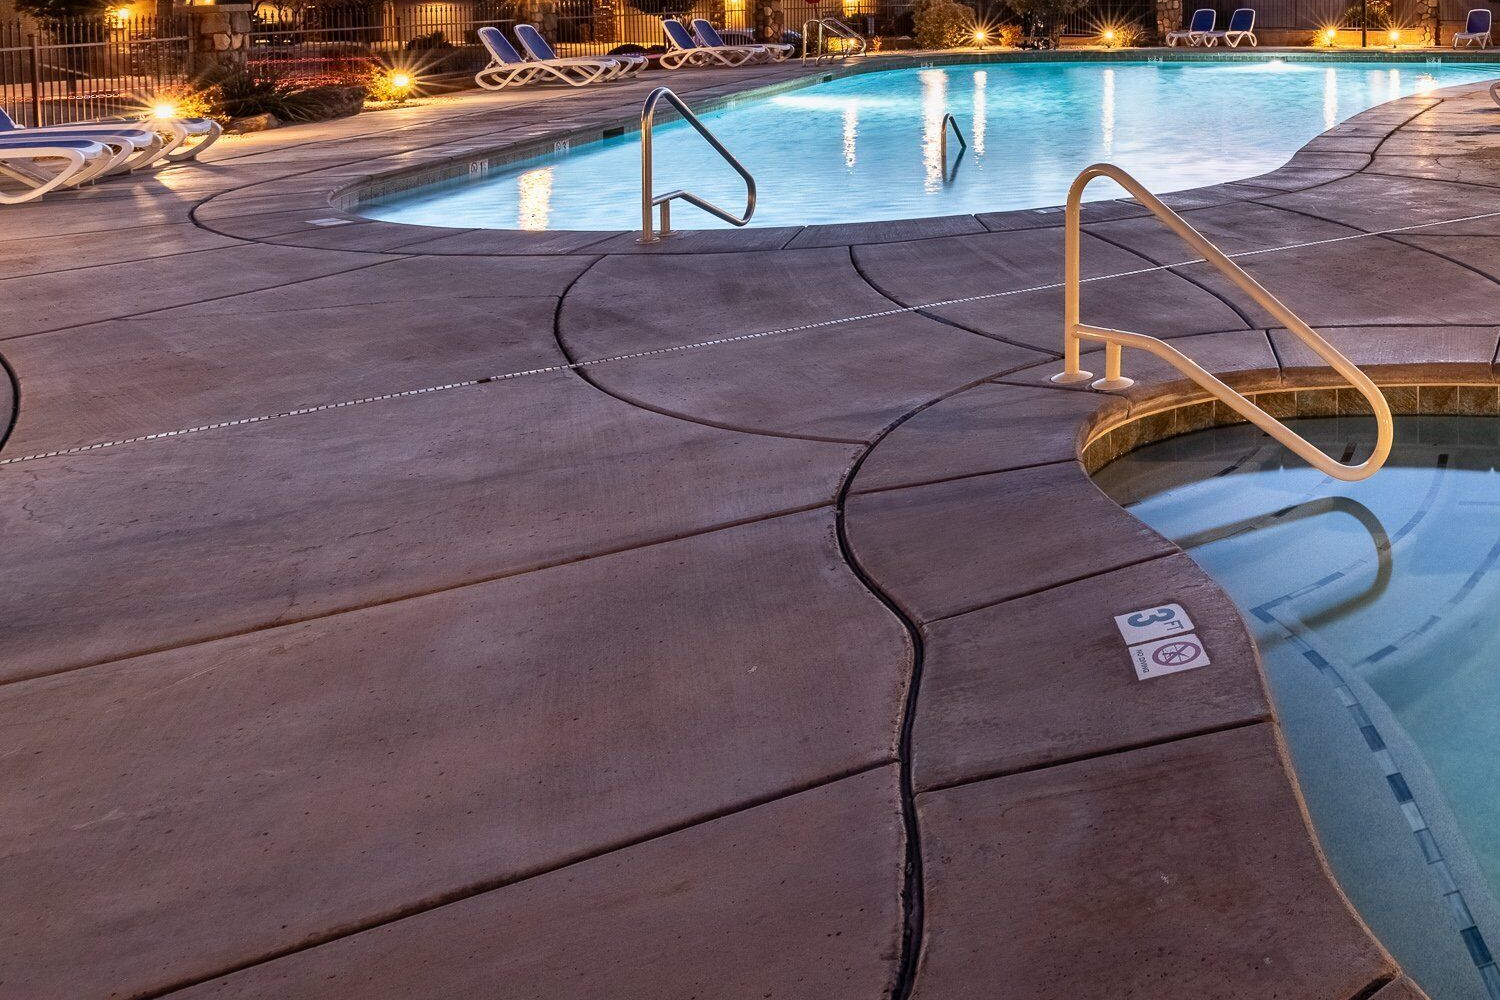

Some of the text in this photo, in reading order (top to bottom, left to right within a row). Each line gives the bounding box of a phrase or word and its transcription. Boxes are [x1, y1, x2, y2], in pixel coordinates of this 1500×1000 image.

[1127, 608, 1185, 631] 3 FT
[1136, 649, 1150, 674] NO DIVING
